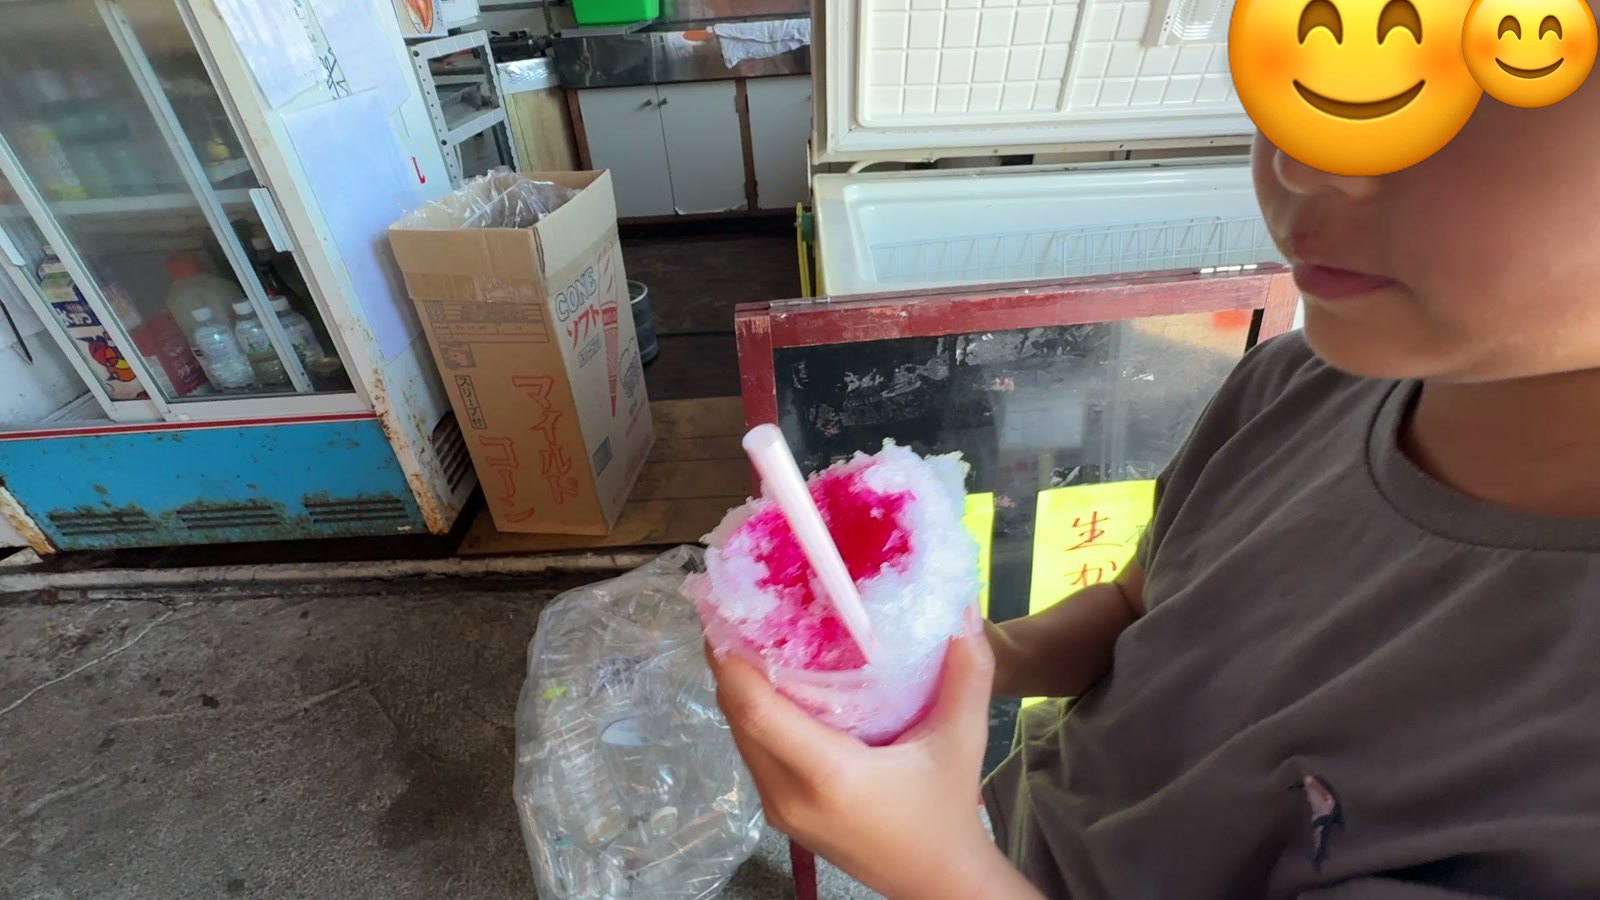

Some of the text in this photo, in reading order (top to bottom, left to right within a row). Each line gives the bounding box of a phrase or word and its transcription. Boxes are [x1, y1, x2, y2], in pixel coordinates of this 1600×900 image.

[555, 266, 598, 322] CONE
[566, 304, 600, 350] ソフト
[512, 374, 580, 505] マイルド
[478, 434, 535, 524] コーン
[1064, 511, 1123, 551] 生
